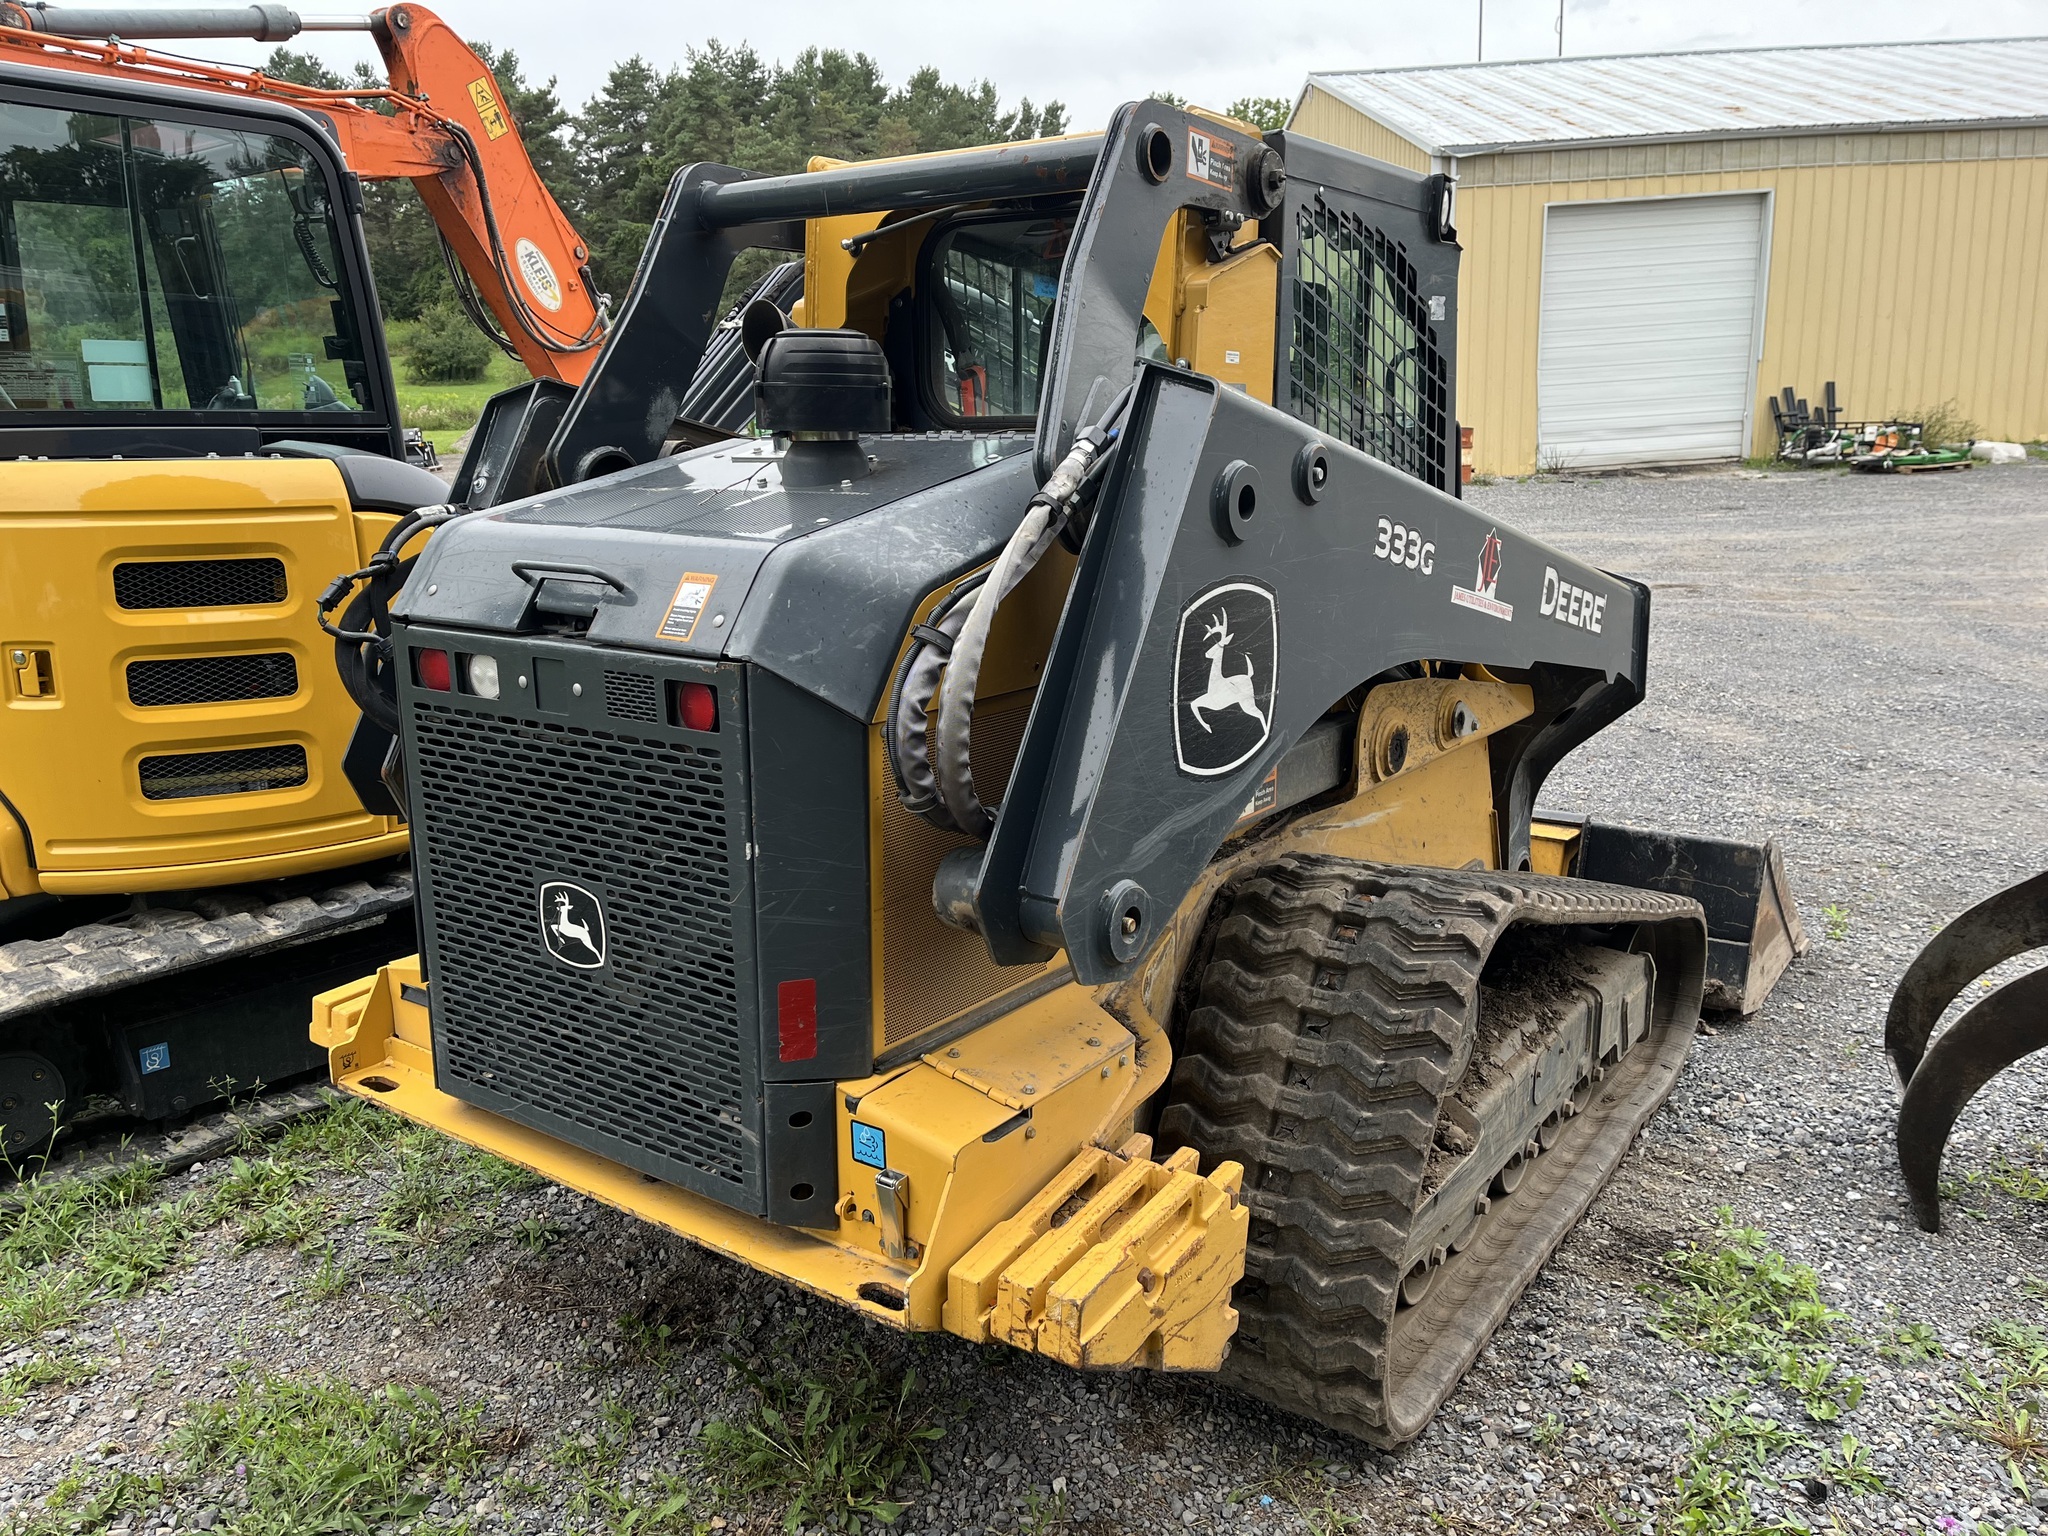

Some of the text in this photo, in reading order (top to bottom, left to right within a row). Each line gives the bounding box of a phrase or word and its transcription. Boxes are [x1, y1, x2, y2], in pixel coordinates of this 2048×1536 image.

[524, 250, 553, 291] KLEIS
[1374, 517, 1436, 576] 333G
[1540, 565, 1607, 634] DEERE
